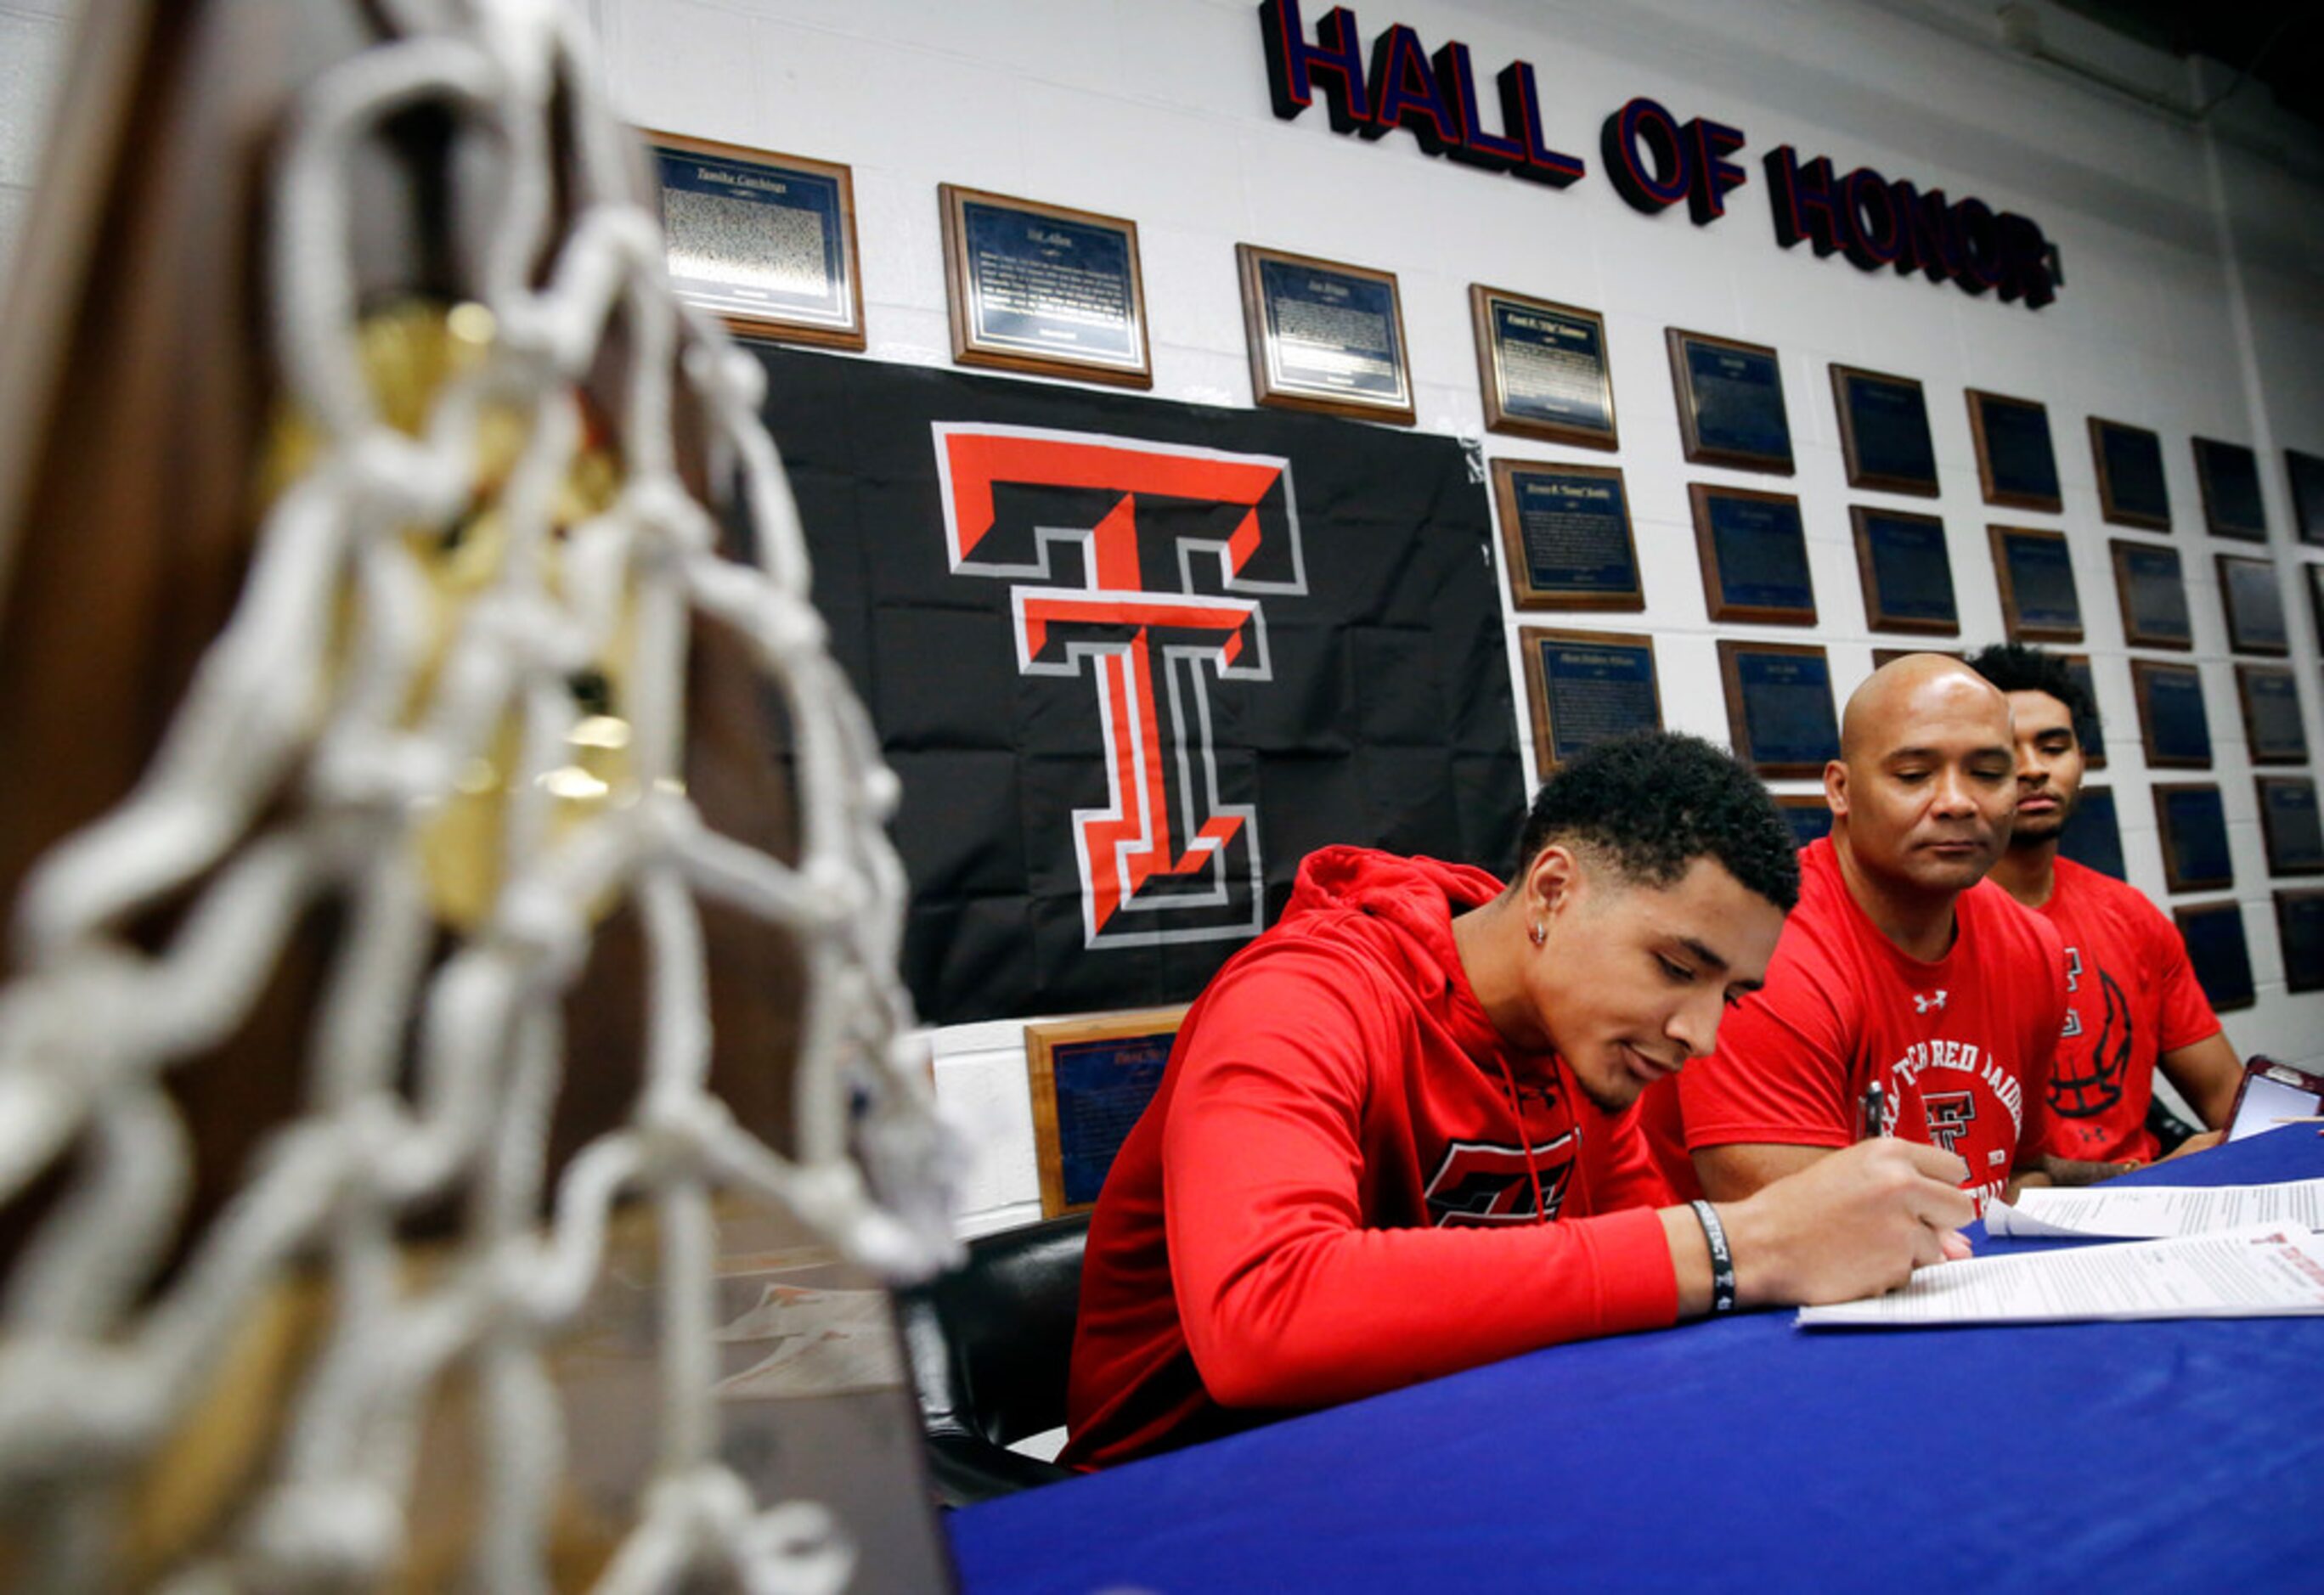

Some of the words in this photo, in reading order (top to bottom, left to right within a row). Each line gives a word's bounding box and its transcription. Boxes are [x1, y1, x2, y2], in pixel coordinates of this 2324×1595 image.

[1259, 0, 1586, 189] HALL
[1600, 96, 1746, 228] OF
[1763, 144, 2062, 311] HONOR
[1930, 1039, 1980, 1073] RED
